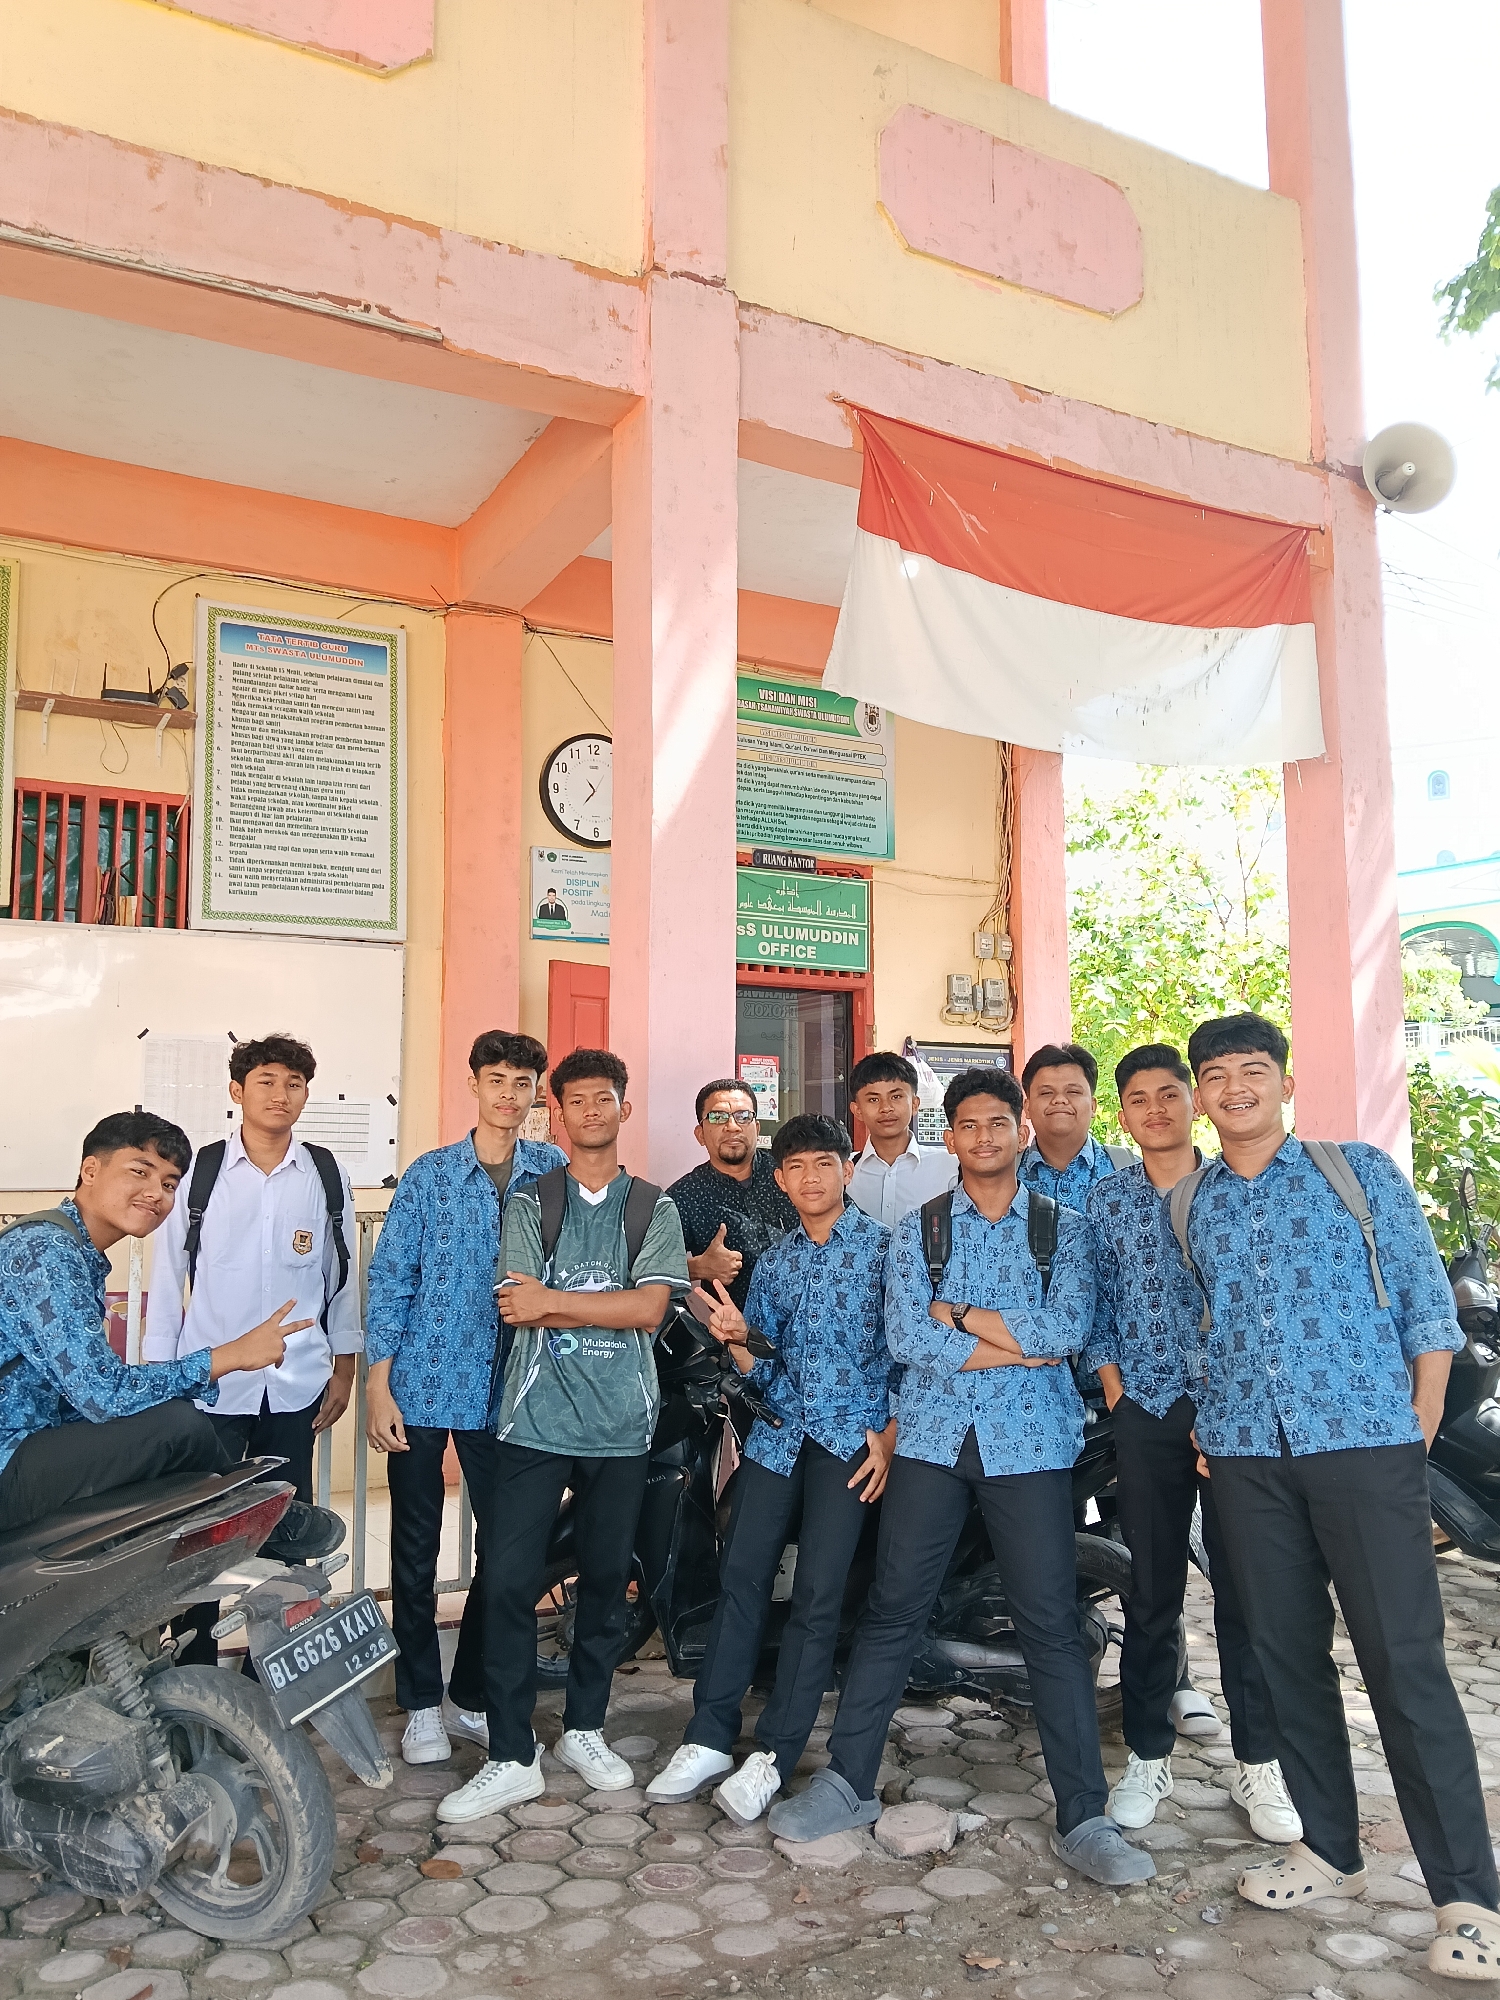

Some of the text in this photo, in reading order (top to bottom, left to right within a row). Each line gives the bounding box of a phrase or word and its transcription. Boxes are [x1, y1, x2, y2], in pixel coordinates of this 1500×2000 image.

[258, 633, 347, 653] TATA TERTIB GURU
[267, 646, 306, 658] SWASTA
[309, 652, 363, 667] ULUMUDDIN
[758, 688, 817, 707] VISI DAN MISI
[793, 708, 817, 720] SWASTA
[569, 748, 580, 759] 11
[588, 744, 600, 756] 12
[555, 762, 568, 773] 10
[553, 783, 560, 793] 9
[560, 802, 564, 814] 8
[574, 820, 580, 830] 7
[593, 827, 600, 838] 6
[762, 854, 786, 866] RUANG
[566, 878, 599, 888] DISIPLIN
[562, 888, 593, 897] POSITIF
[761, 924, 858, 946] ULUMUDDIN
[758, 942, 816, 959] OFFICE
[582, 1338, 627, 1349] Mubadala
[582, 1348, 615, 1358] Energy
[290, 1615, 314, 1633] HONDA
[268, 1603, 376, 1689] BL 6626 KAV
